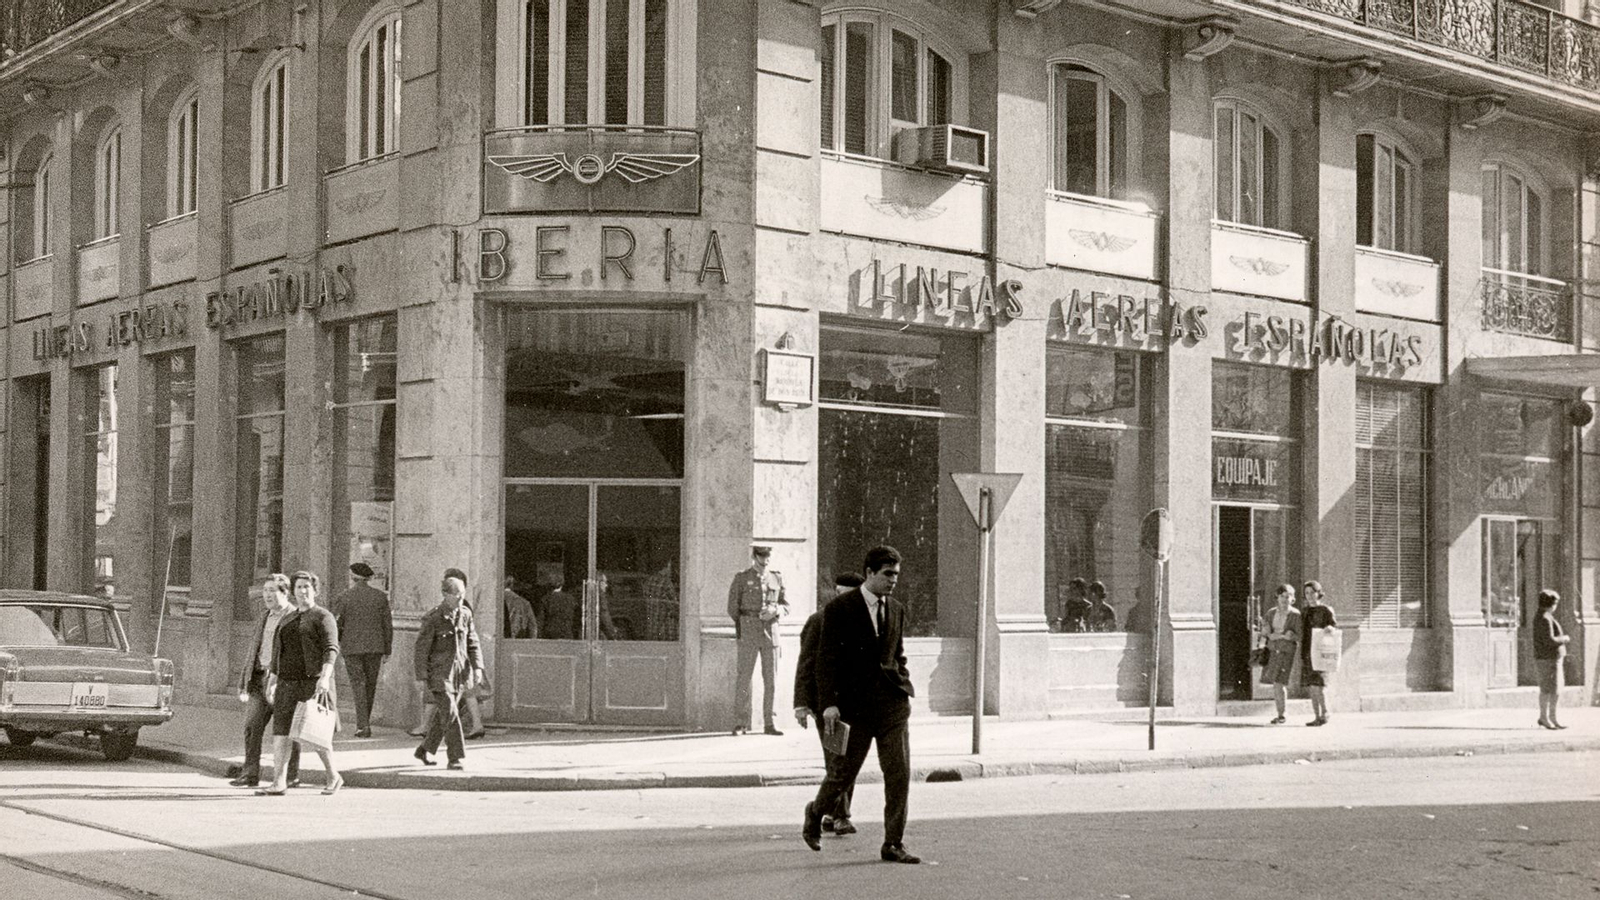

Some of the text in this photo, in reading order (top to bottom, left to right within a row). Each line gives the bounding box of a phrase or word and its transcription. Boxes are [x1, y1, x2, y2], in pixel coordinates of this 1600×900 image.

[451, 226, 729, 285] IBERIA
[32, 263, 356, 361] LINEAS AEREAS ESPAÑOLAS
[872, 258, 1423, 367] LINEAS AEREAS ESPAÑOLAS
[1217, 456, 1277, 486] EQUIPAJE
[88, 685, 94, 695] V
